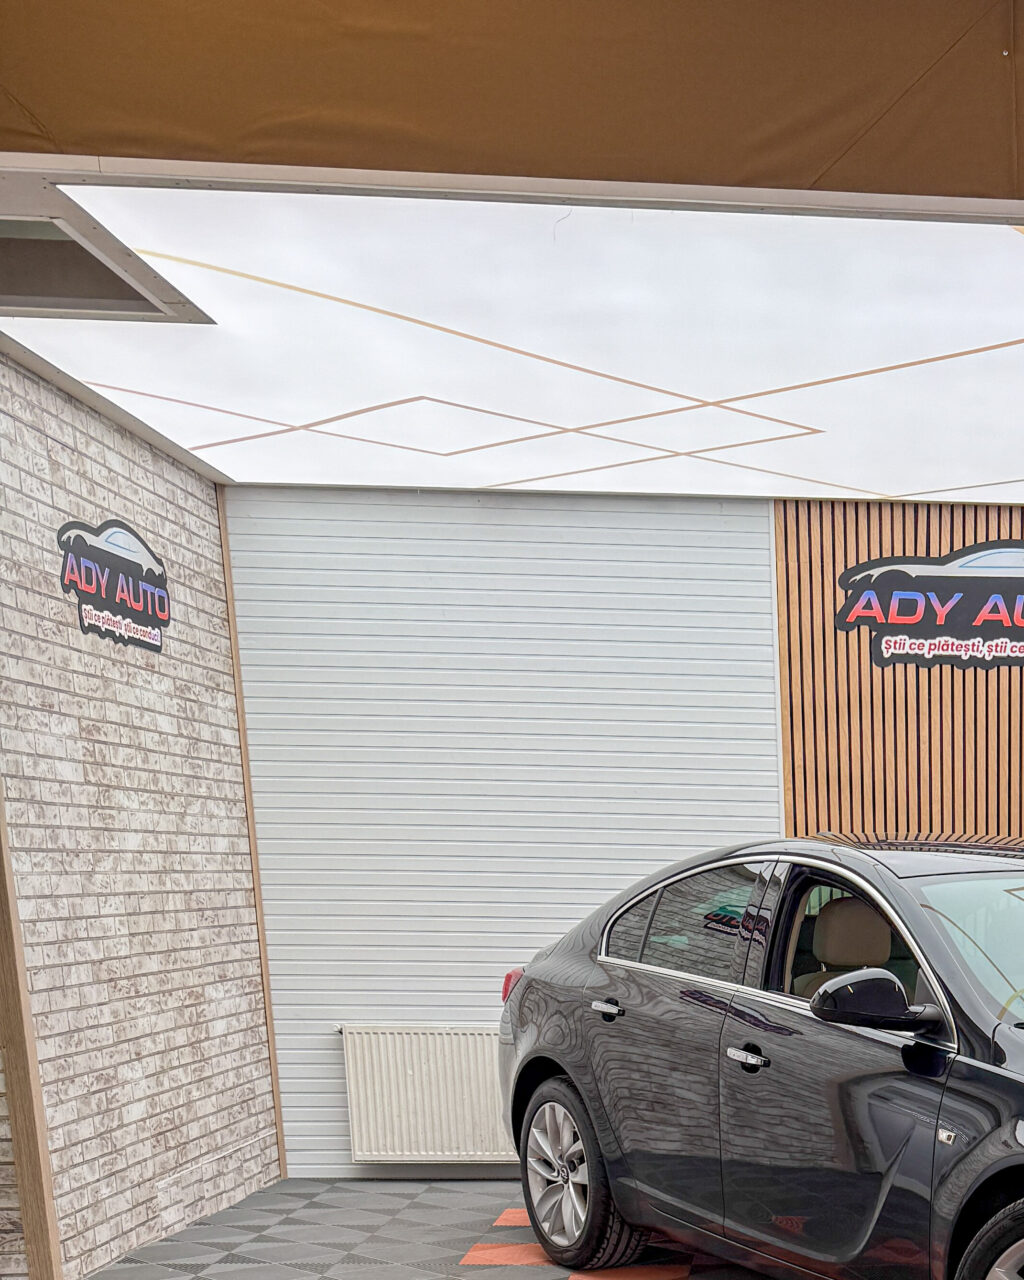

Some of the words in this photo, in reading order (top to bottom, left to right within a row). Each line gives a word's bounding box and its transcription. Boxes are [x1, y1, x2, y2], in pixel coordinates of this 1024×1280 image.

[64, 553, 110, 599] ADY
[116, 573, 170, 621] AUTO
[846, 590, 963, 625] ADY
[884, 639, 906, 653] Știi
[909, 642, 925, 651] ce
[927, 640, 983, 655] plătești,
[986, 642, 1007, 655] știi
